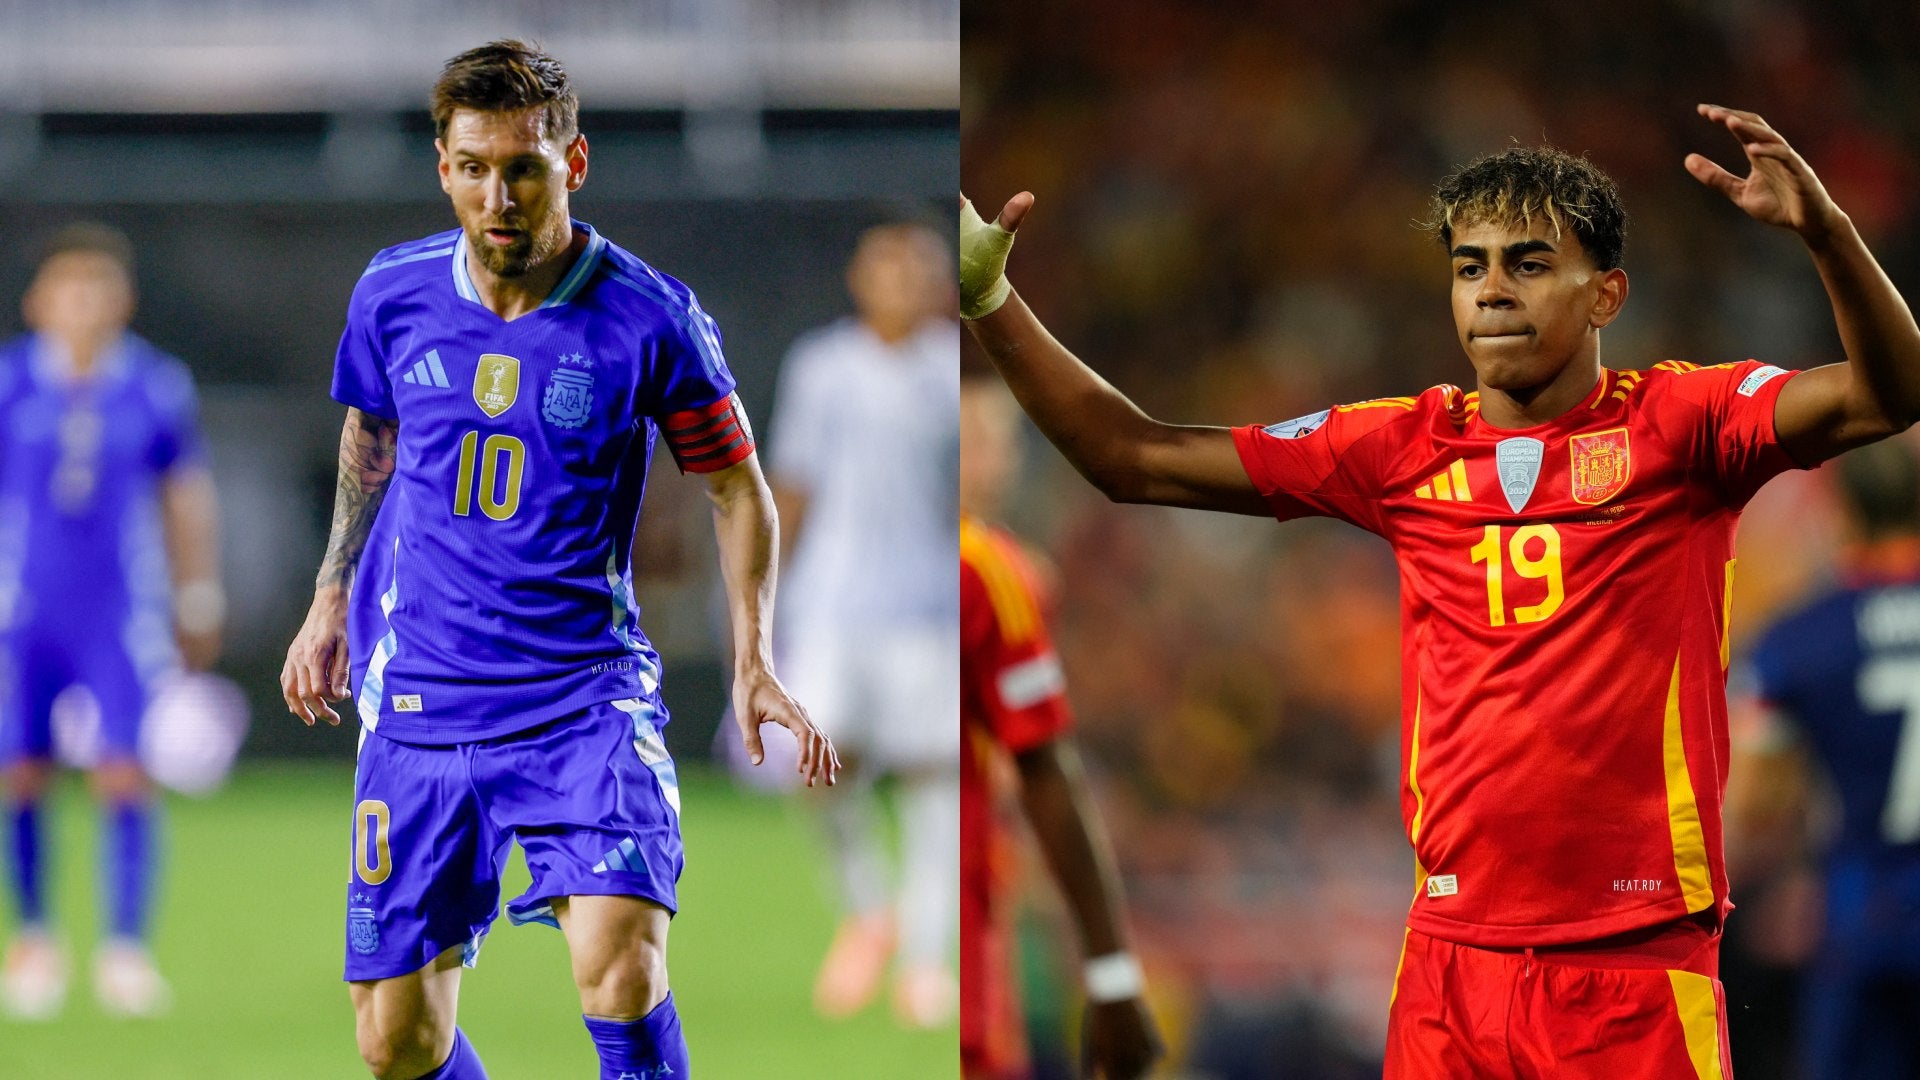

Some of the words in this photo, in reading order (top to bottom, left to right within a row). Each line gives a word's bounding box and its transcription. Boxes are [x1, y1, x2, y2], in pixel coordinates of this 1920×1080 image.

[485, 392, 504, 402] FIFA
[554, 386, 580, 412] AFA
[1500, 447, 1539, 456] EUROPEAN
[1500, 455, 1538, 463] CHAMPIONS
[454, 430, 525, 521] 10
[1508, 487, 1528, 495] 2024
[1470, 523, 1564, 627] 19
[591, 661, 633, 675] HEAT.RDY
[349, 799, 393, 886] 0
[1613, 879, 1662, 892] HEAT.RDY
